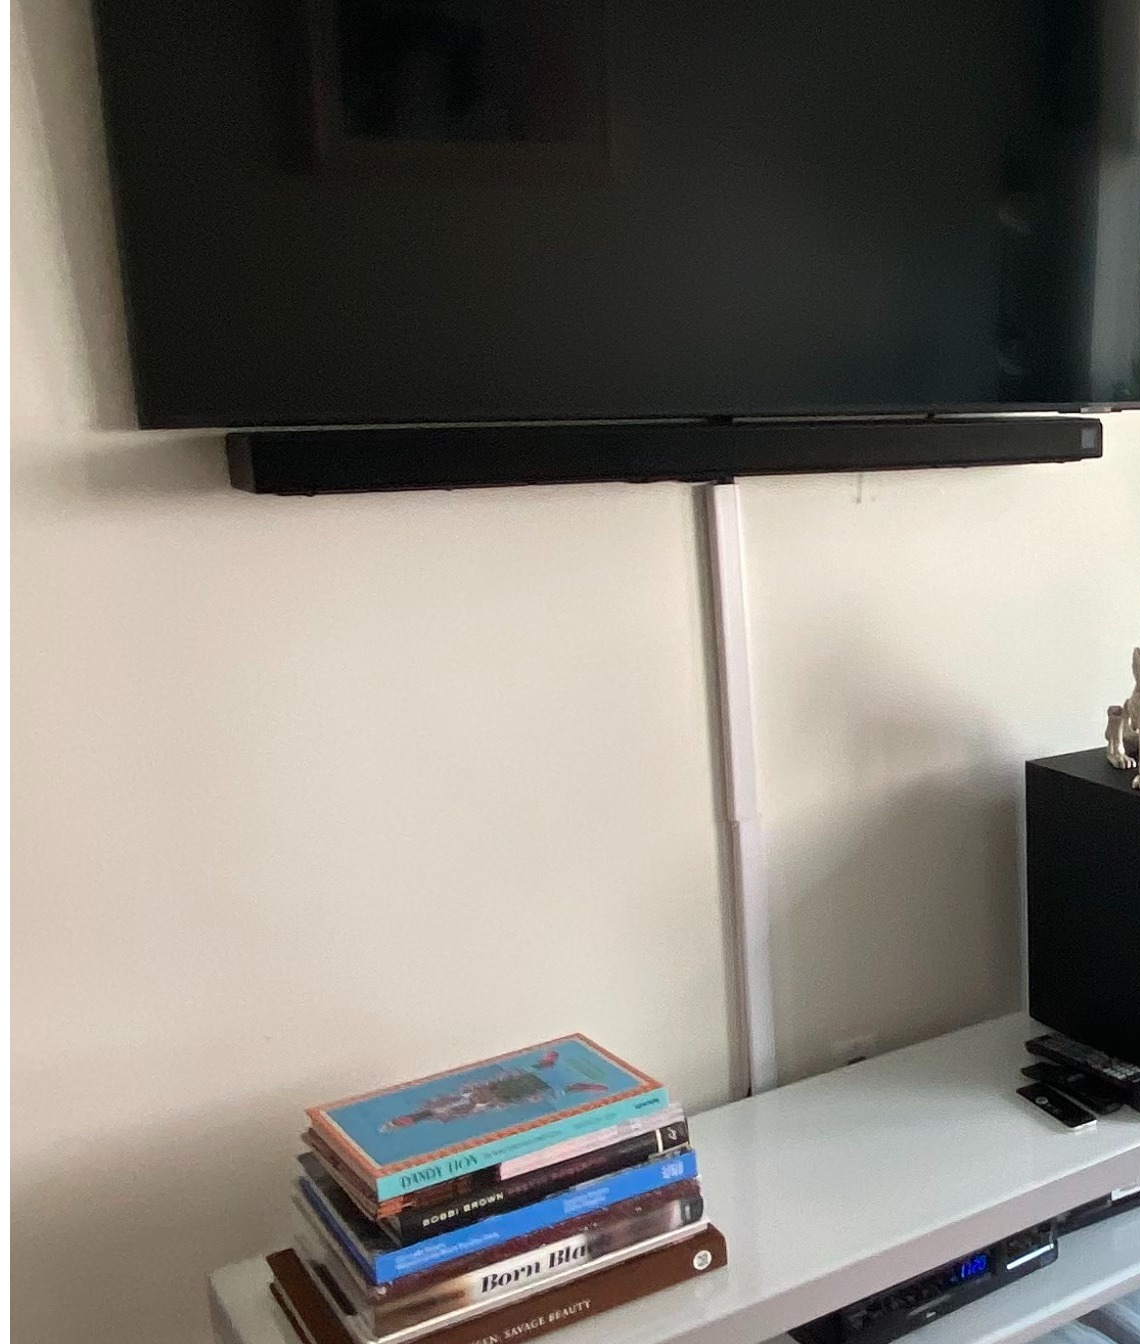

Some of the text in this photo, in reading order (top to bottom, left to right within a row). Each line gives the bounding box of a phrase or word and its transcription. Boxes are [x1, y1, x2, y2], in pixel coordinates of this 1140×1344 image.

[400, 1165, 443, 1191] DANDY
[422, 1191, 505, 1227] BOBBI BROWN
[480, 1259, 541, 1293] Born
[503, 1316, 546, 1340] SAVAGE
[548, 1299, 593, 1323] BEAUTY
